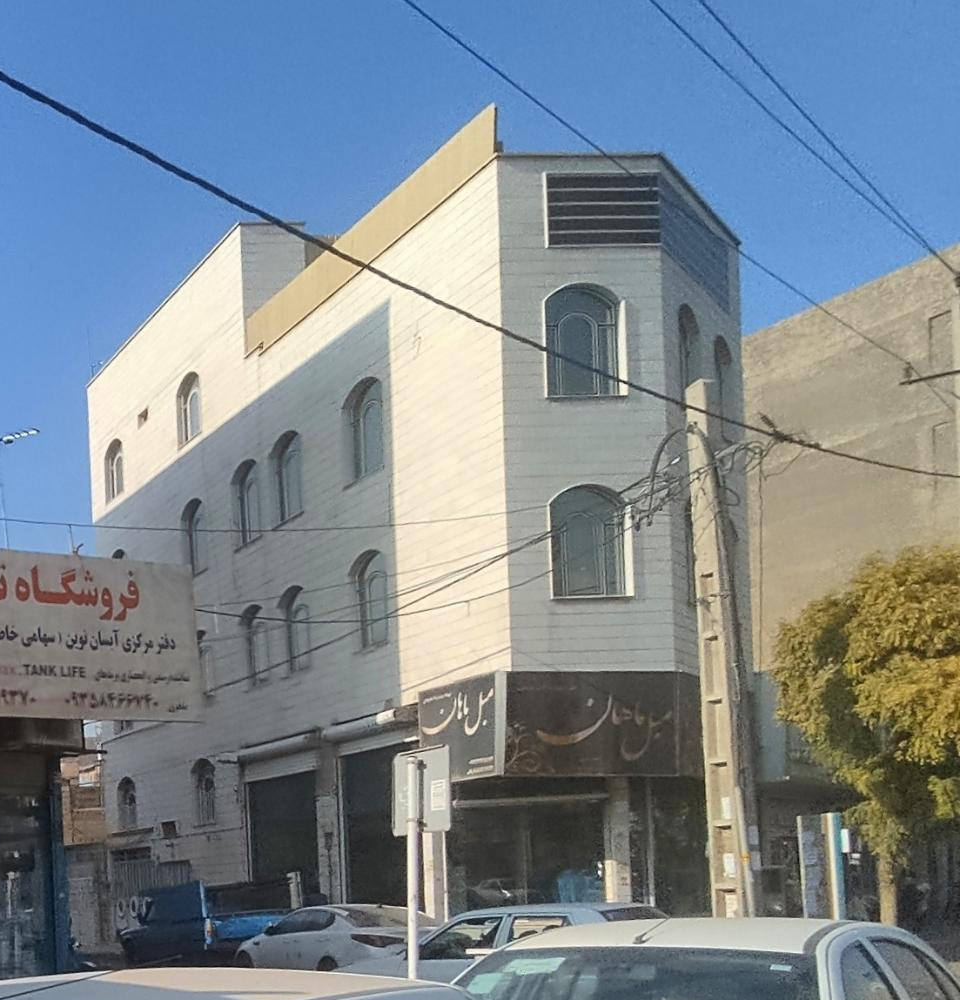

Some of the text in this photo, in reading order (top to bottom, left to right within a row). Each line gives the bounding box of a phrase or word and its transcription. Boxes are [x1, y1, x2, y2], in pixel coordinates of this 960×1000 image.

[15, 565, 140, 621] فروشگاه
[60, 665, 86, 678] LIFE
[464, 688, 494, 736] مبل
